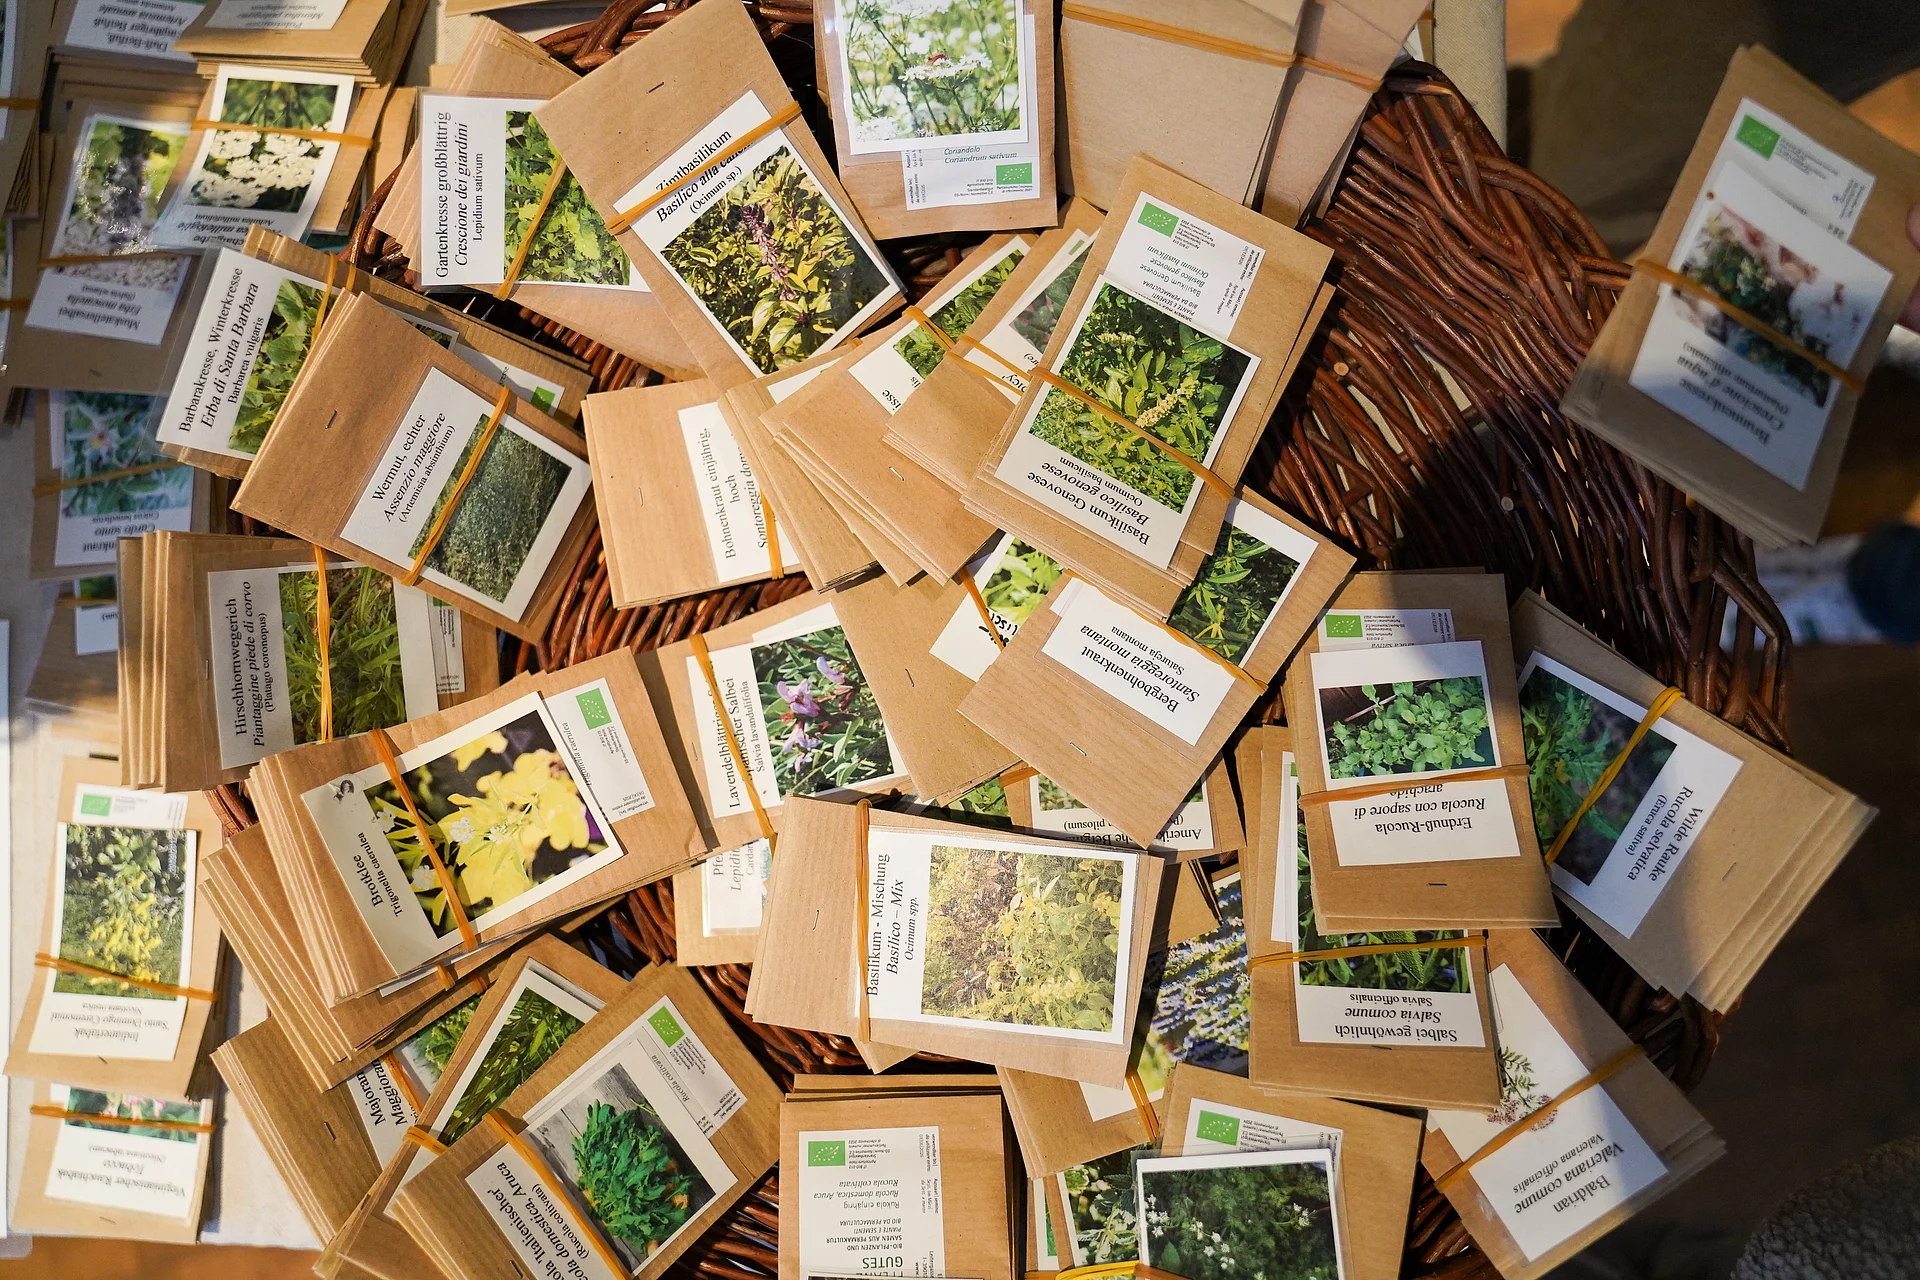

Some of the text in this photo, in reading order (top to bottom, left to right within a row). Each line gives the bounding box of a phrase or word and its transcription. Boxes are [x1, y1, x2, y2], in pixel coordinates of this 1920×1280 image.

[943, 145, 980, 155] Coriandolo
[944, 154, 987, 163] Coriandrum
[434, 112, 451, 277] Gartenkresse großblättrig
[454, 122, 470, 265] Crescione dei giardini
[472, 153, 484, 240] Lepidium sativum
[656, 165, 719, 222] Basilico alla
[689, 165, 741, 213] (Ocimum sp.)
[1139, 263, 1201, 297] Basilikum Genovese
[1142, 280, 1181, 301] PERMACULTURA
[1146, 245, 1208, 278] Ocimum basilicum
[1149, 257, 1205, 287] Basilico genovese
[1151, 292, 1195, 316] PIANTE SEMENTI
[1187, 301, 1198, 309] BIO
[178, 349, 217, 431] Barbarakresse,
[207, 268, 242, 342] Winterkresse
[200, 283, 258, 427] Erba di Santa Barbara
[227, 317, 263, 403] Barbarea vulgaris
[371, 414, 425, 499] Wermut, echter
[384, 412, 445, 522] Assenzio maggiore
[398, 425, 455, 522] (Artemisia absinthium)
[1059, 456, 1142, 506] Ocimum basilicum
[697, 428, 736, 558] Bohnenkraut einjährig,
[724, 474, 740, 503] hoch
[741, 478, 769, 550] Sontoreggia
[1027, 472, 1149, 545] Basilikum Genovese
[1041, 462, 1148, 525] Basilico genovese
[94, 523, 156, 536] Cardo santo
[224, 598, 247, 735] Hirschhornwegerich
[242, 581, 264, 746] Piantaggine piede di corvo
[257, 612, 275, 712] (Platago coronopus)
[1080, 625, 1199, 702] Santoreggia montana
[1081, 646, 1179, 712] Bergbohnenkraut
[1111, 626, 1184, 675] Satureja montana
[722, 678, 739, 714] Salbei
[562, 722, 595, 787] Trigonella caerulea
[708, 700, 742, 809] Lavendelblättri
[739, 680, 764, 772] Salvia lavandulifolia
[1354, 798, 1484, 819] Rucola con sapore di
[1389, 782, 1443, 800] arachide
[1063, 818, 1105, 831] pilosum)
[1374, 817, 1471, 834] Erdnuß-Rucola
[1624, 794, 1667, 855] (Eruca sativa)
[1627, 786, 1693, 880] Rucola selvatica
[1648, 807, 1703, 881] Wilde Rauke
[353, 854, 383, 906] Brotklee
[357, 832, 402, 917] Trigonella caerulea
[865, 853, 890, 997] Basilikum Mischung
[886, 879, 903, 974] Basilico Mix
[904, 897, 919, 960] Ocimum spp.
[1344, 1007, 1441, 1023] Salvia comune
[1349, 993, 1432, 1006] Salvia officinalis
[1334, 1025, 1457, 1042] Salbei gewöhnlich
[367, 1057, 412, 1128] Maggioran
[651, 1054, 673, 1080] coltivata
[671, 1080, 690, 1102] Rucola
[352, 1069, 390, 1127] Majoran
[496, 1162, 526, 1195] Aruca
[838, 1179, 898, 1188] Rucola coltivata
[1512, 1133, 1604, 1193] Valeriana officinalis
[1514, 1142, 1623, 1213] Valeriana comune
[531, 1183, 589, 1259] (Rucola coltivata)
[836, 1190, 873, 1198] domestica,
[839, 1218, 882, 1226] PERMACULTURA
[843, 1200, 899, 1210] Rukola einjährig
[875, 1189, 898, 1198] Rucola
[1552, 1174, 1610, 1212] Baldrian
[487, 1188, 545, 1264] 'Italienischer'
[525, 1197, 569, 1257] domestica,
[860, 1242, 902, 1250] BIO-PFLANZEN
[862, 1255, 902, 1269] GUTES
